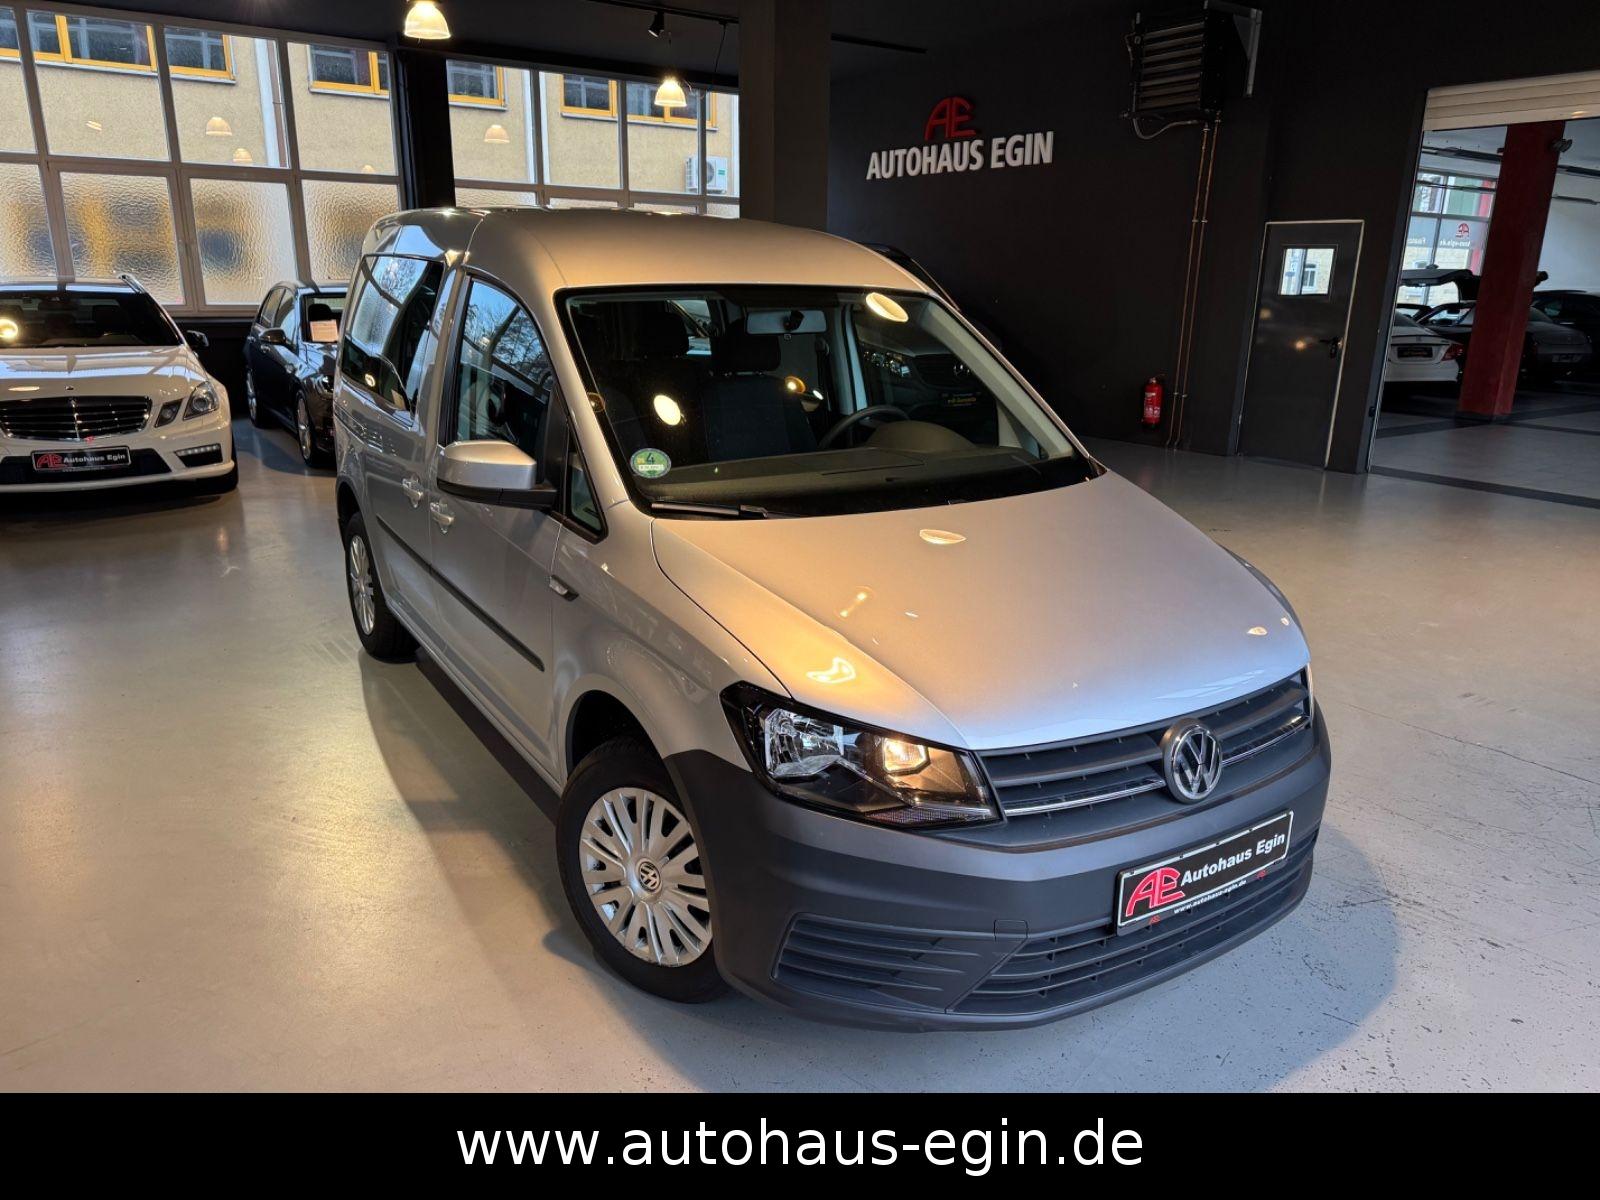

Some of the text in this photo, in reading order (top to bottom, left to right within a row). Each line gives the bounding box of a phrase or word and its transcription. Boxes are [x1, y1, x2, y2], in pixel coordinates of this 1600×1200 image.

[866, 131, 1054, 180] AUTOHAUS EGIN
[63, 454, 126, 463] Autohaus Egin
[1180, 833, 1286, 887] Autohaus Egin
